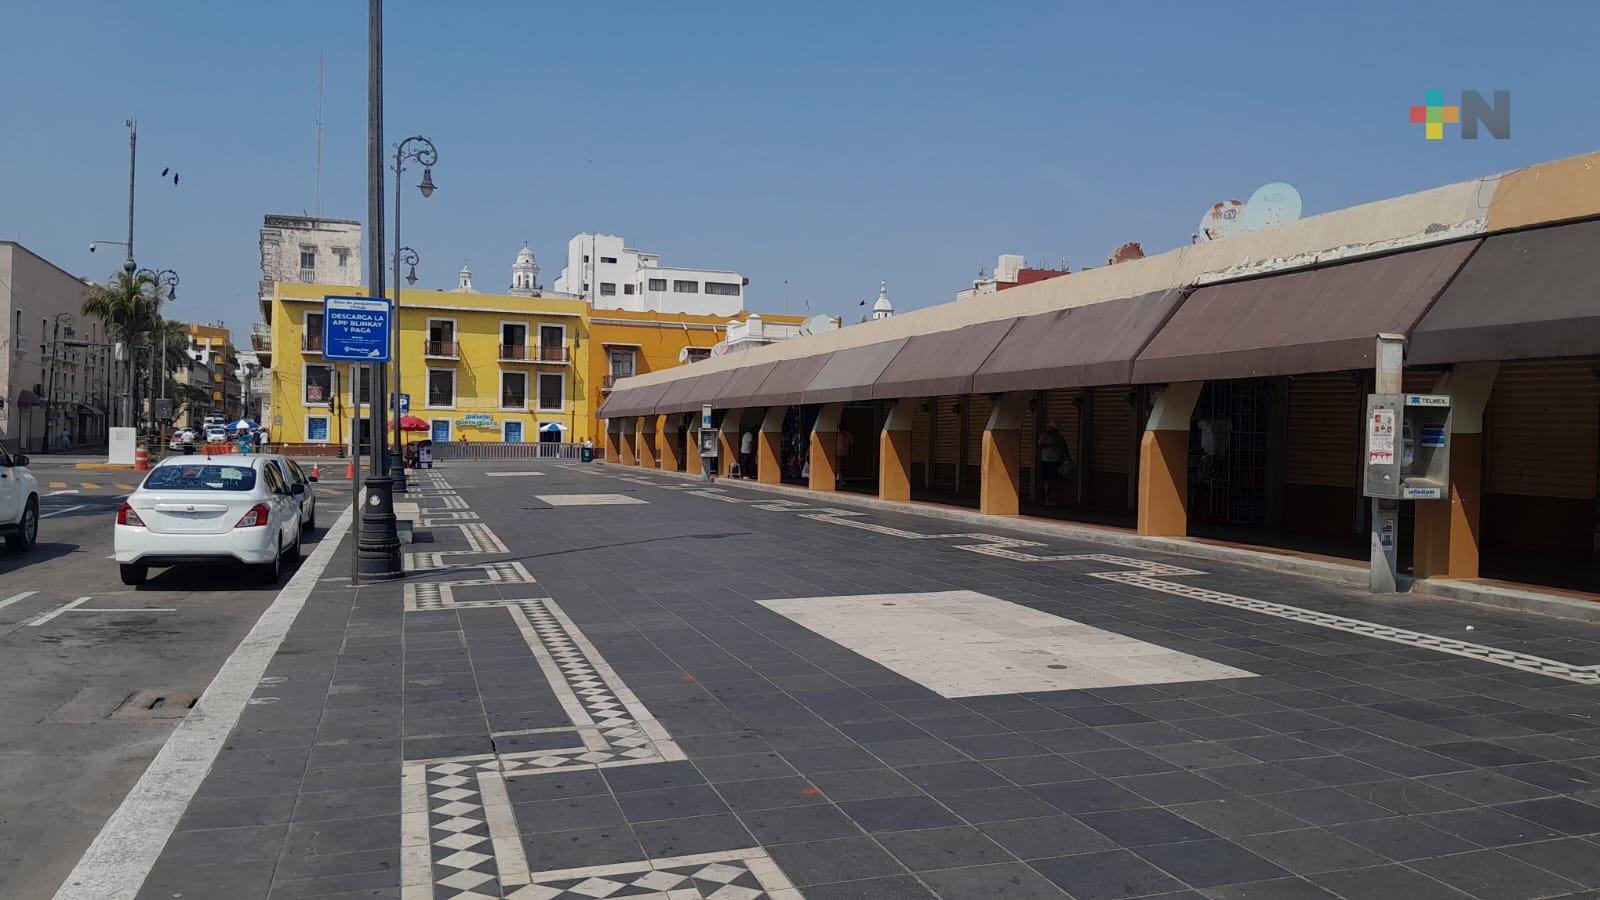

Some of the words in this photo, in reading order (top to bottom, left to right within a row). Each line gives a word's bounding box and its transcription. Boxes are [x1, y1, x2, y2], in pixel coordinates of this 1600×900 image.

[331, 313, 373, 321] DESCARGA
[350, 320, 383, 328] BLINKAY
[399, 398, 408, 409] P
